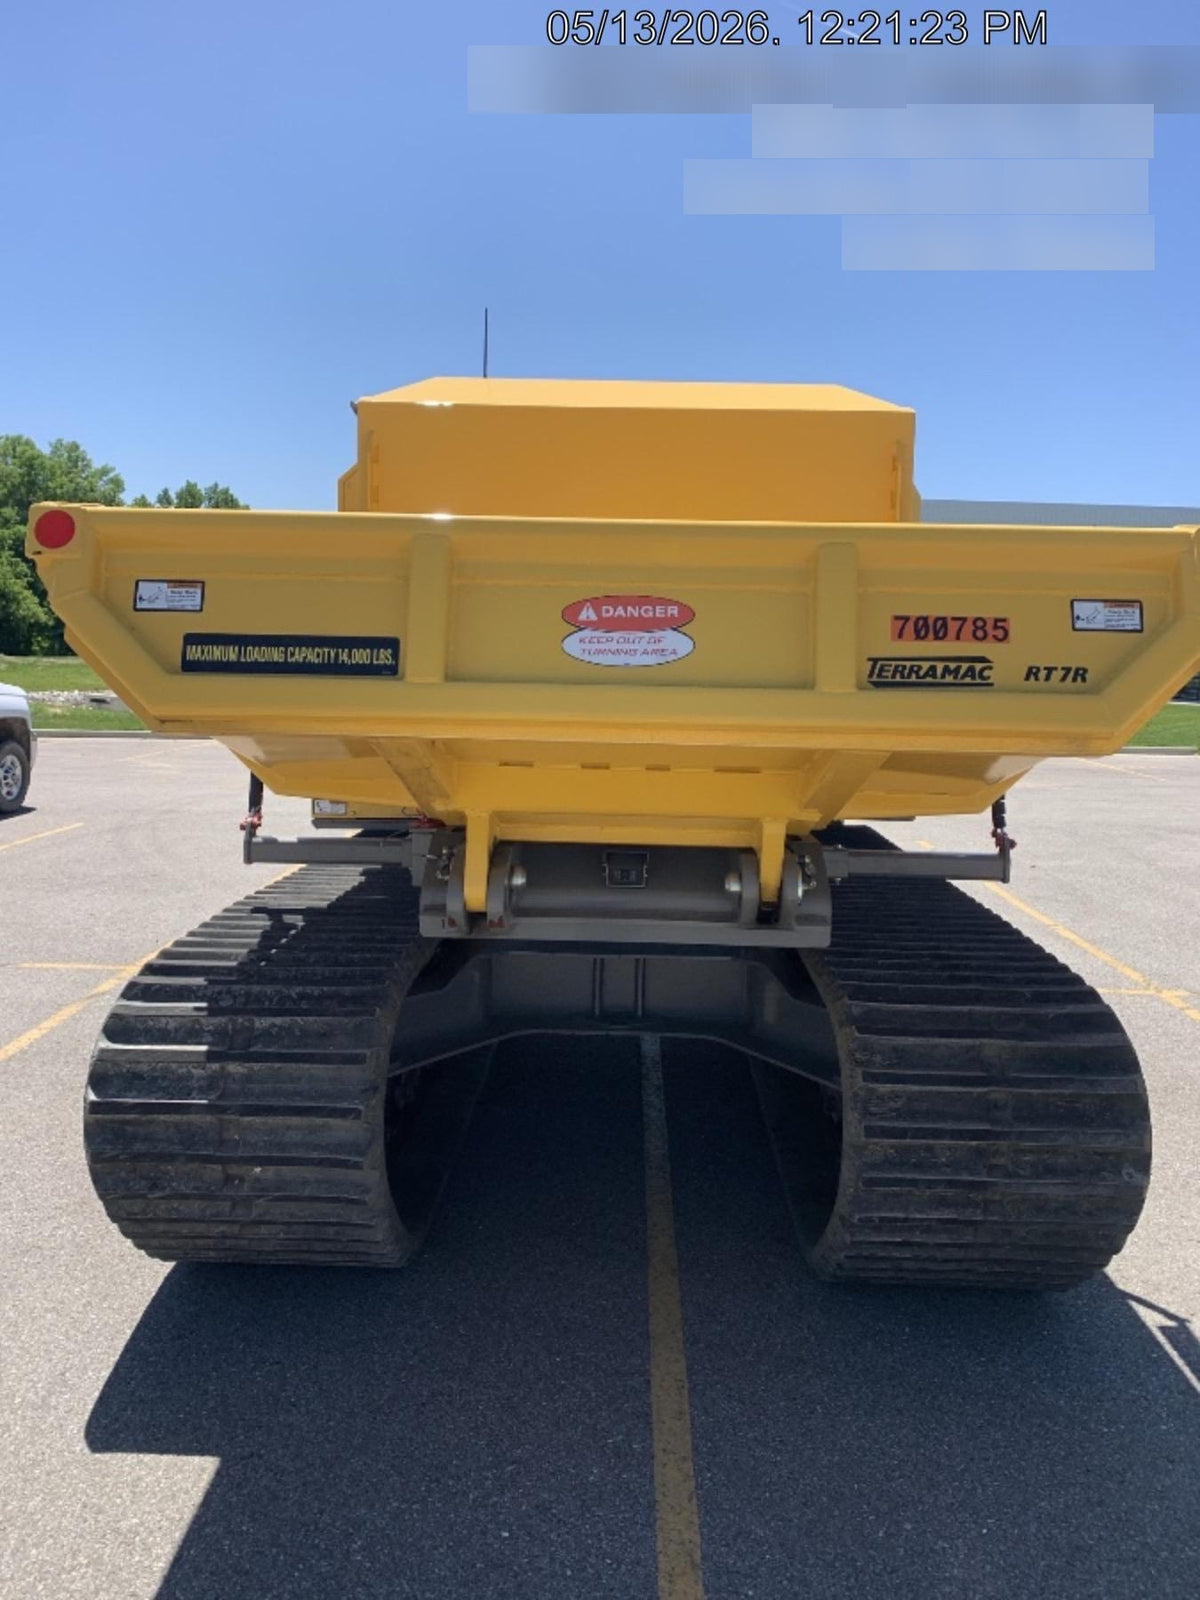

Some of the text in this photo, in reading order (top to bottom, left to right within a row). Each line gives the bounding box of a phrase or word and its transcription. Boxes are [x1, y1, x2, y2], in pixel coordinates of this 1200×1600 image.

[601, 605, 679, 618] DANGER
[893, 615, 1010, 642] 700785
[578, 635, 666, 645] KEEP OUT OF
[185, 643, 396, 666] MAXIMUM LOADING CAPACITY 14,000 LBS.
[580, 647, 679, 657] TURNING AREA
[867, 656, 995, 686] TERRAMAC
[1024, 665, 1090, 683] RT7R
